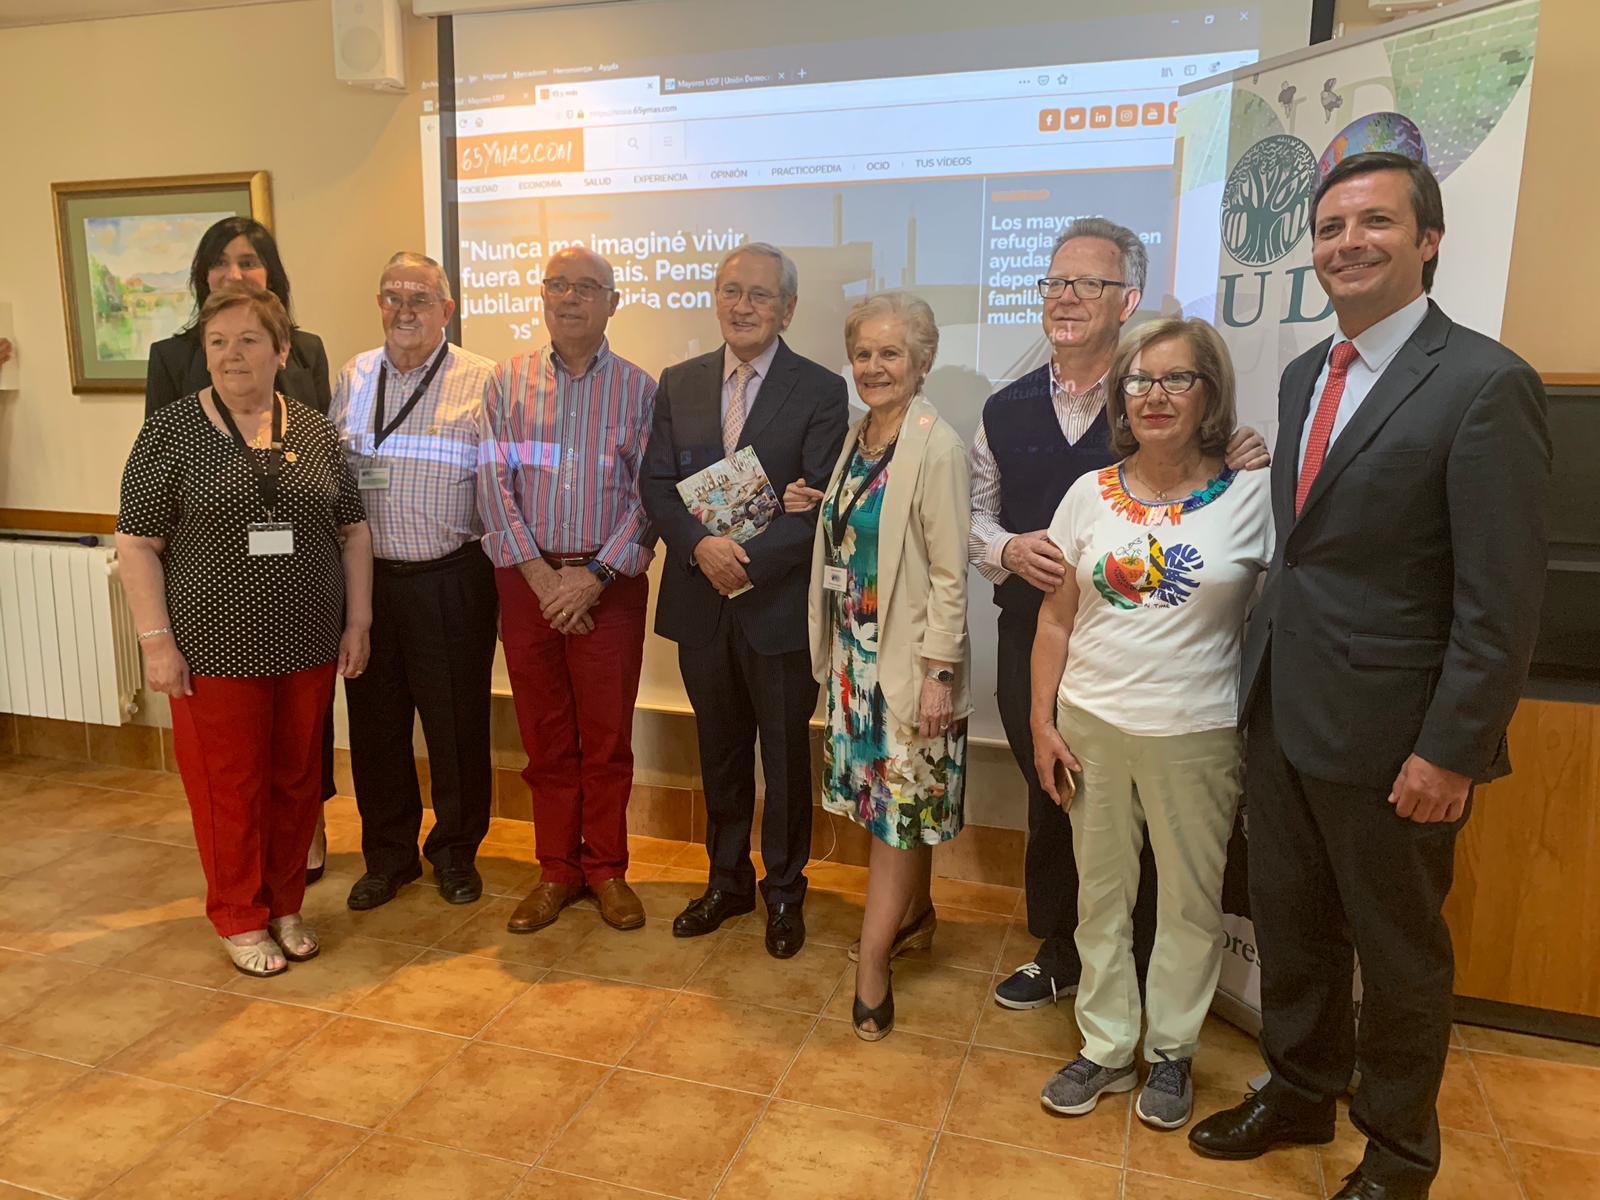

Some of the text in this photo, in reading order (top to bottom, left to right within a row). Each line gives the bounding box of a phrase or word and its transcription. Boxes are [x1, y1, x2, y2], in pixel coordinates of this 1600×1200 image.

[459, 183, 498, 195] SOCIEDAD
[584, 176, 612, 187] SALUD
[633, 171, 689, 184] EXPERIENCIA
[710, 168, 748, 181] OPINIÓN
[771, 163, 842, 177] PRACTICOPEDIA
[866, 160, 890, 172] OCIO
[915, 158, 935, 169] TUS
[936, 155, 973, 168] VÍDEOS
[991, 215, 1022, 231] Los
[591, 230, 687, 261] imaginé
[692, 227, 745, 252] vivir
[990, 233, 1055, 252] refugia
[989, 251, 1051, 272] ayudas
[461, 266, 521, 289] fuera
[525, 263, 545, 286] d
[612, 260, 649, 284] aís.
[988, 272, 1047, 290] depen
[666, 289, 712, 310] con
